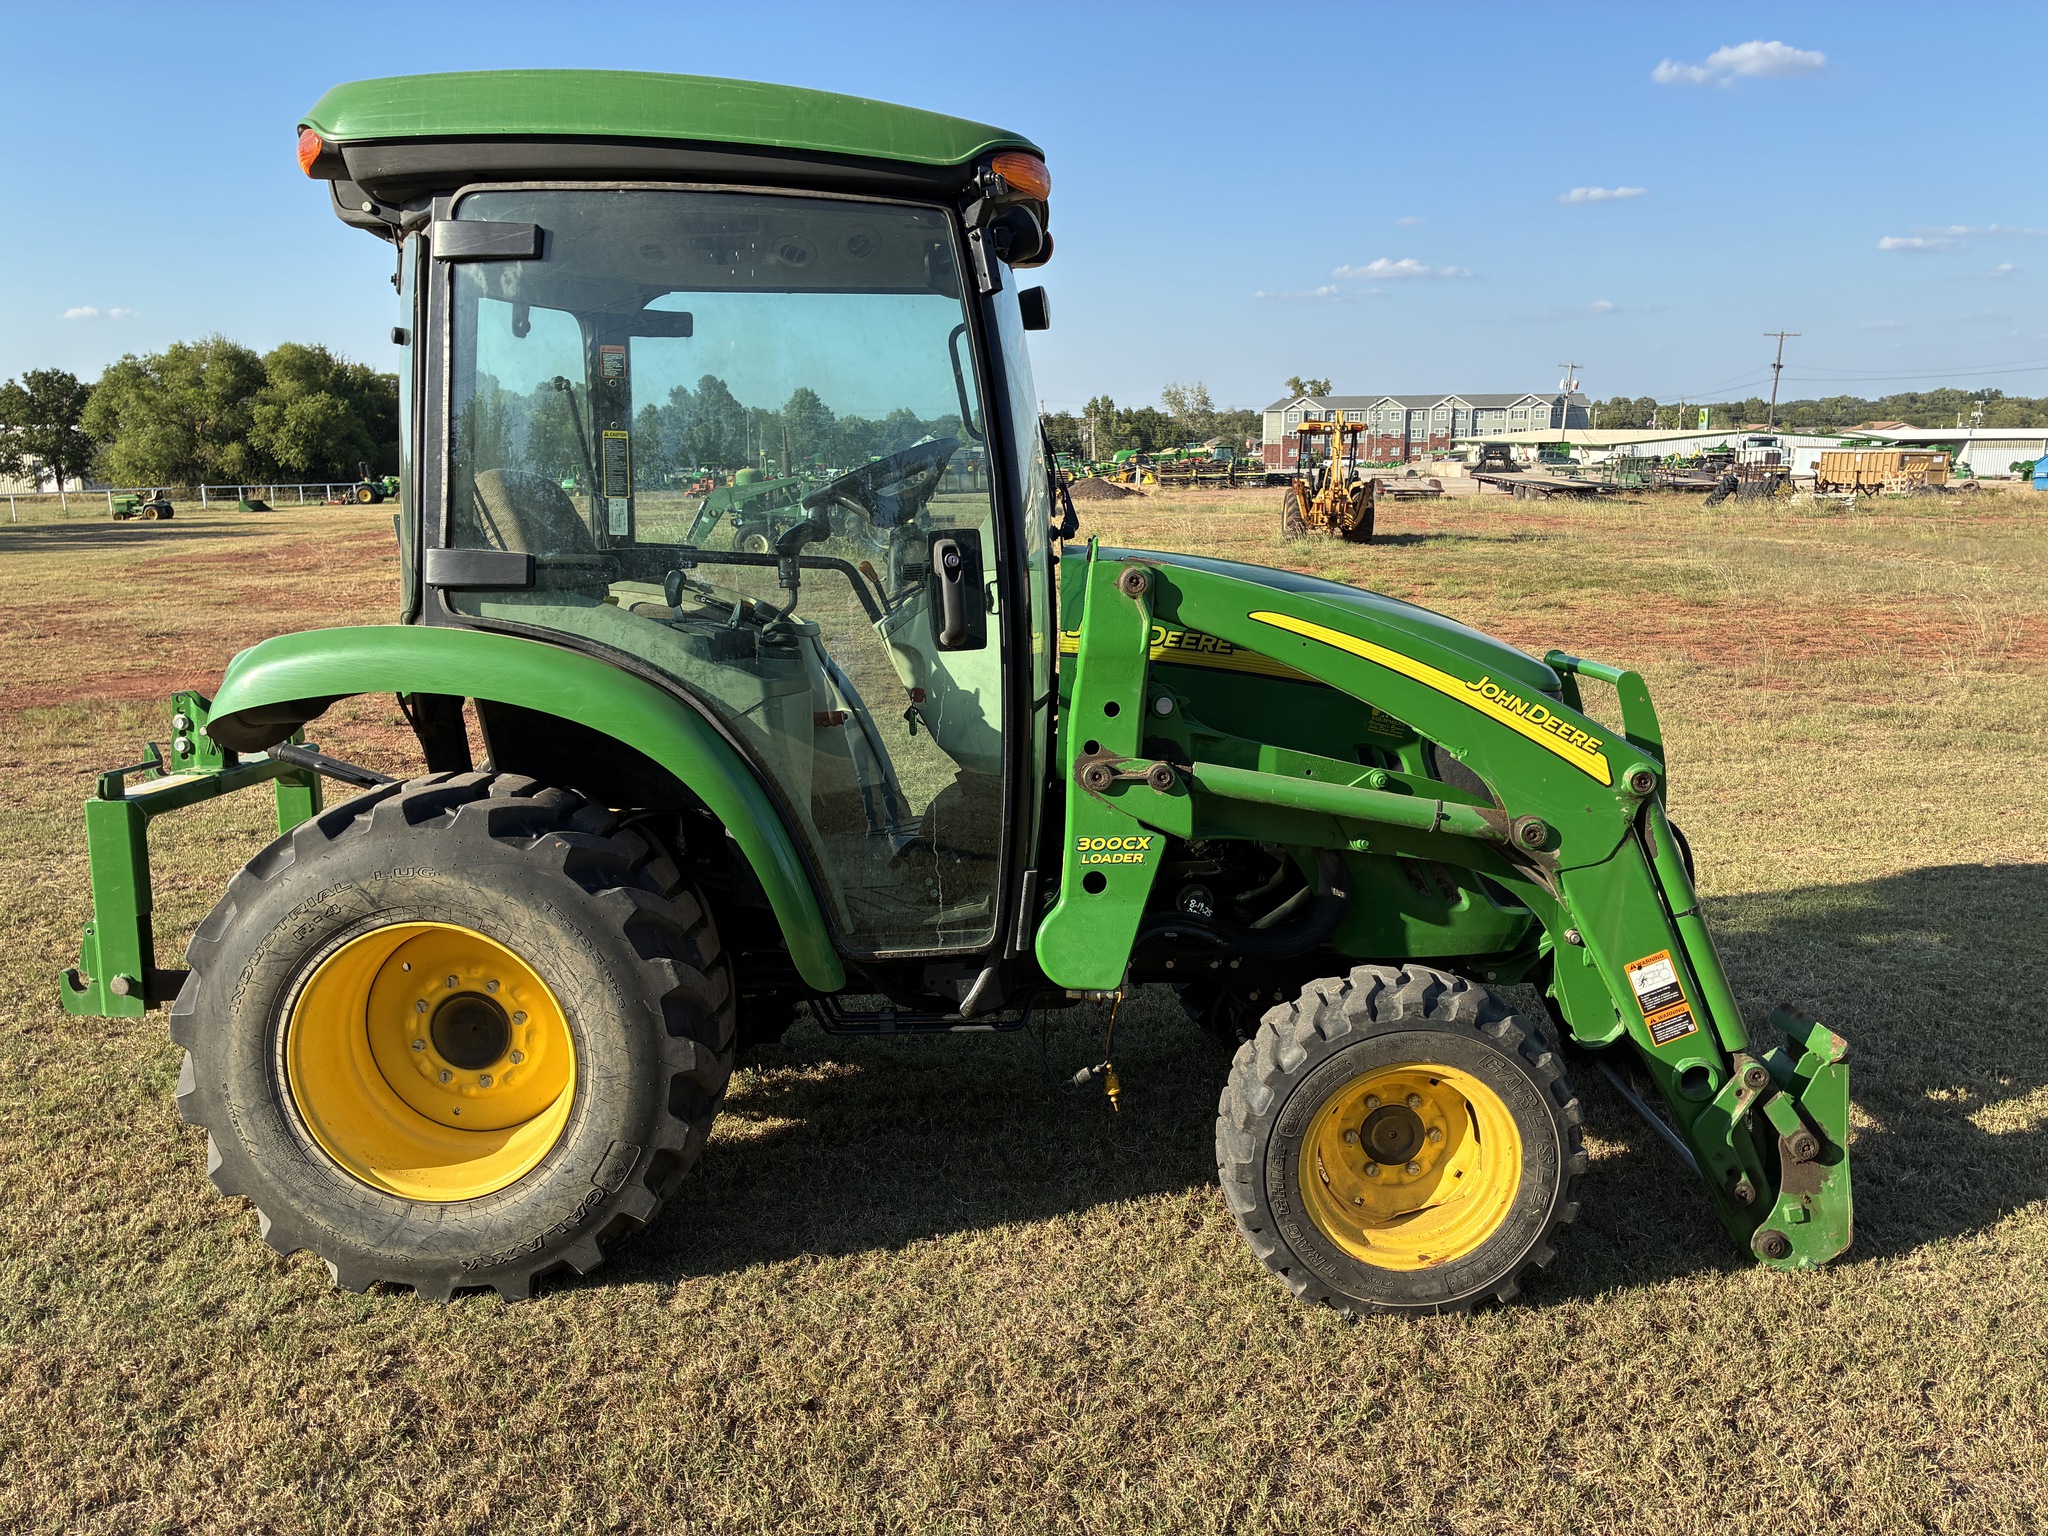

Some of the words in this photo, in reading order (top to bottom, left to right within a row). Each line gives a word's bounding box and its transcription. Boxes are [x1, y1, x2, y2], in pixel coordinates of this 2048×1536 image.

[1150, 625, 1233, 654] DEERE
[1077, 836, 1153, 851] 300CX
[1081, 853, 1144, 864] LOADER
[229, 883, 353, 1014] INDUSTRIAL
[373, 866, 437, 881] LUG
[292, 903, 343, 941] R-4
[1636, 953, 1664, 967] WARNING
[1657, 1006, 1685, 1020] WARNING
[1478, 1054, 1556, 1209] CARLISLE
[1270, 1137, 1291, 1216] CHIEF
[459, 1187, 604, 1270] GALAXY
[1284, 1223, 1337, 1279] TRAC
